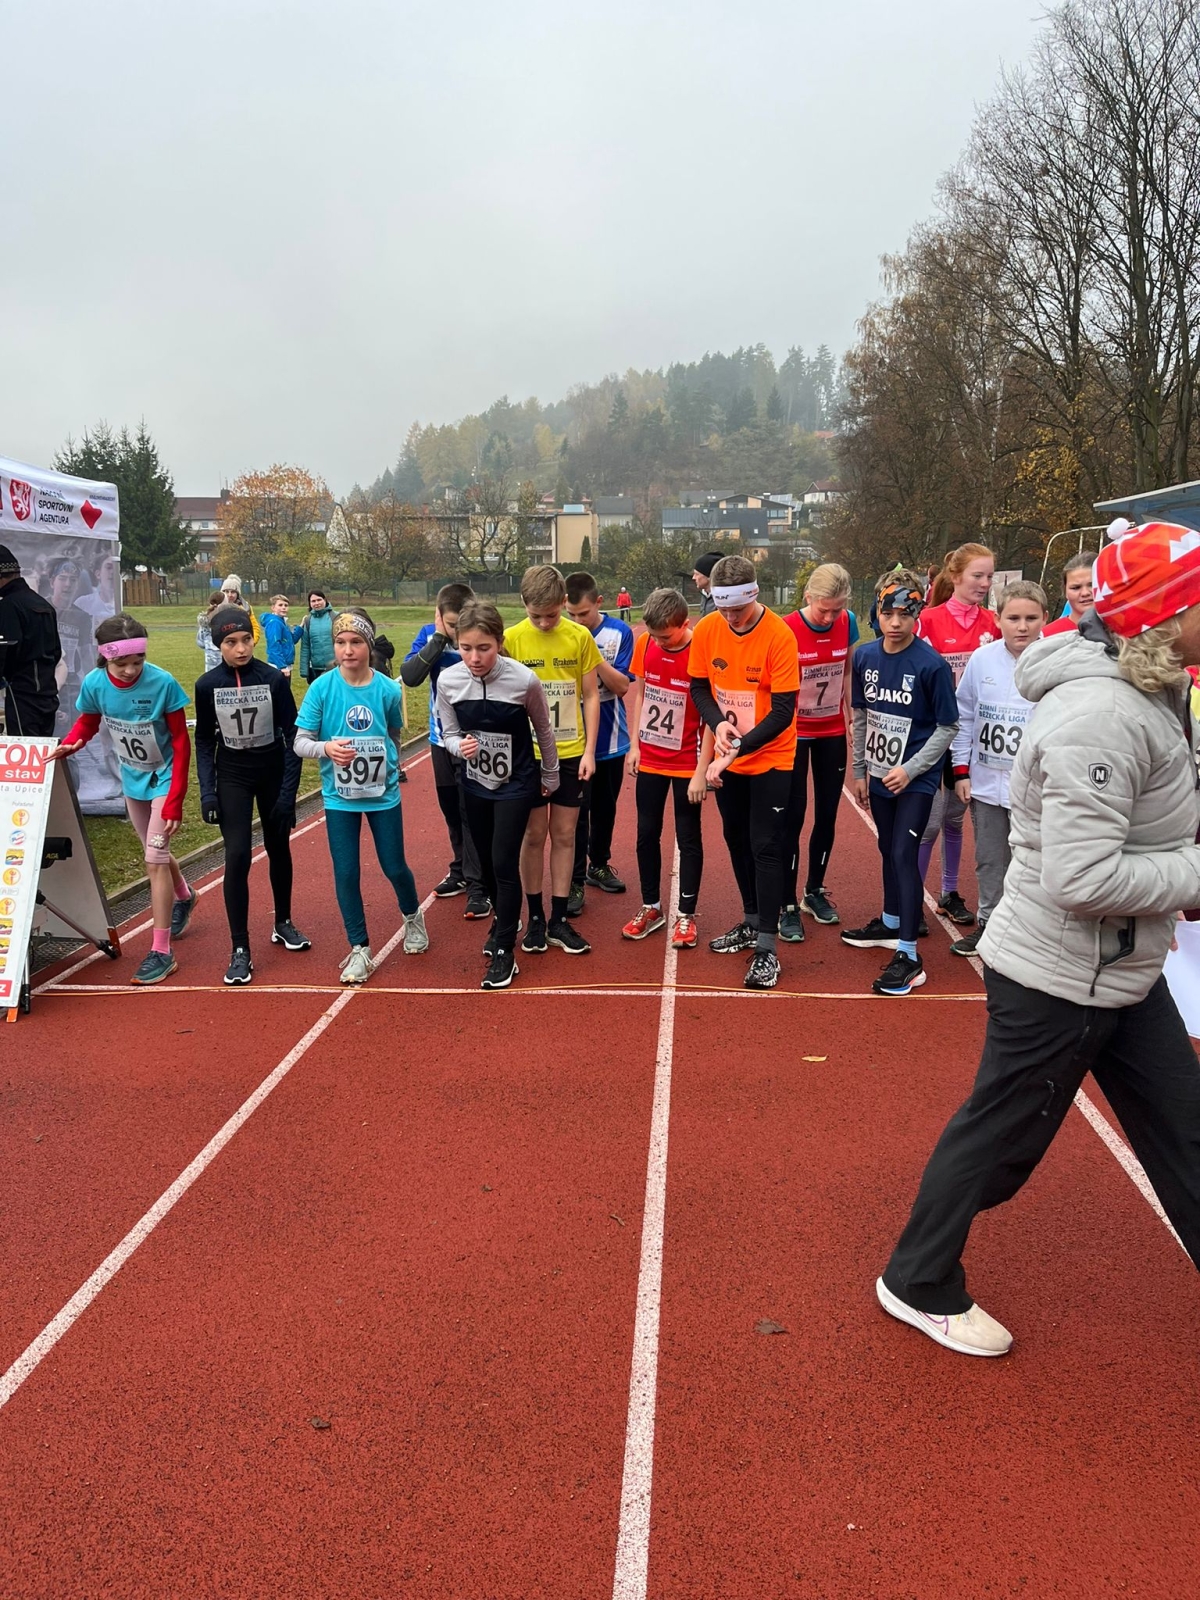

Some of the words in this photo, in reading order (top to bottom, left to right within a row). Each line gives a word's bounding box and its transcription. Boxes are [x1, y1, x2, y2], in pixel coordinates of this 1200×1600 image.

[38, 499, 74, 513] SPORTOVNÍ
[39, 513, 70, 525] AGENTURA
[830, 668, 843, 677] LIGA
[864, 668, 880, 683] 66
[216, 688, 238, 698] ZIMNÍ
[645, 685, 661, 694] ZIMNÍ
[816, 681, 829, 706] 7
[216, 697, 249, 706] BĚŽECKÁ
[251, 694, 269, 704] LIGA
[669, 698, 684, 707] LIGA
[877, 687, 913, 706] JAKO
[737, 700, 753, 708] LIGA
[979, 703, 997, 712] ZIMNÍ
[549, 700, 560, 728] 1
[646, 704, 675, 735] 24
[978, 710, 1005, 721] BĚŽECKÁ
[1008, 715, 1026, 723] LIGA
[230, 706, 258, 736] 17
[135, 729, 152, 737] LIGA
[890, 725, 907, 734] LIGA
[979, 722, 1023, 756] 463
[119, 736, 148, 762] 16
[368, 745, 384, 753] LIGA
[866, 730, 903, 767] 489
[0, 743, 49, 767] ON
[4, 768, 41, 779] stav
[337, 756, 384, 786] 397
[1095, 769, 1105, 781] N
